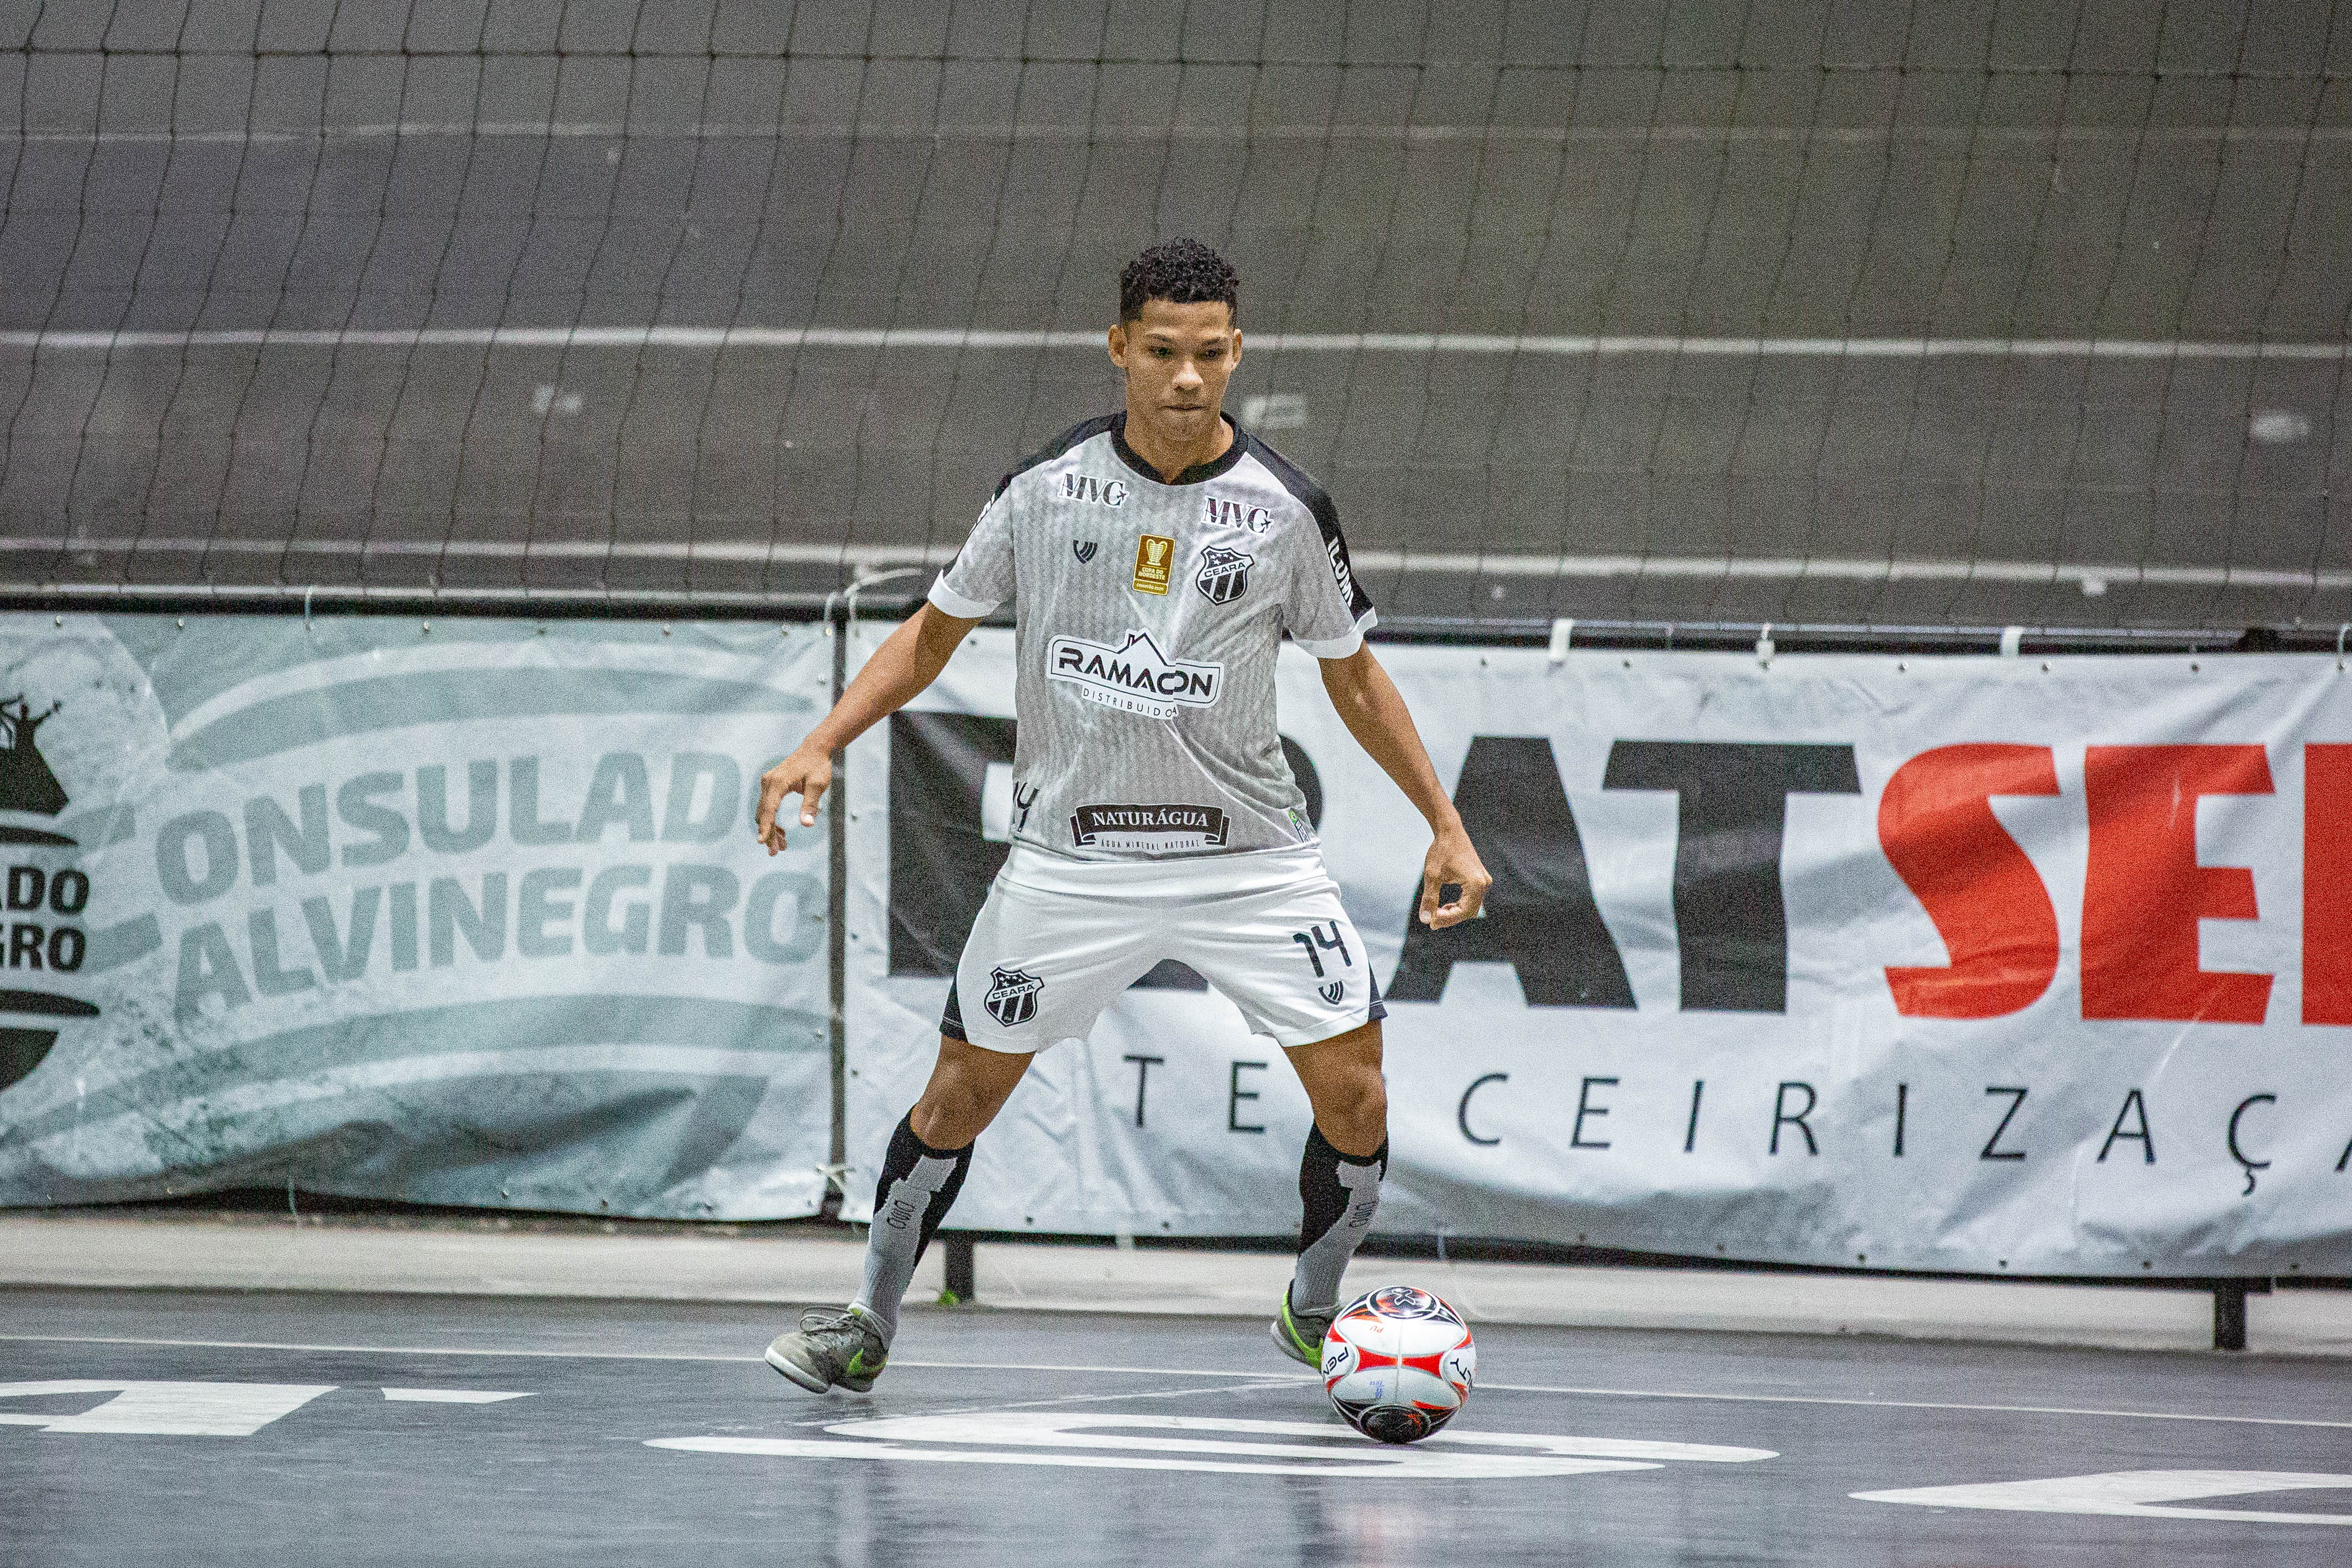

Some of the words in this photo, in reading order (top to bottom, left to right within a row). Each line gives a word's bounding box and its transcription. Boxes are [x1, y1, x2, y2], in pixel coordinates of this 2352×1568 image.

[1059, 473, 1125, 506] MVC
[1202, 497, 1269, 534] MVC
[1138, 571, 1165, 580] NORDESTE
[1091, 808, 1208, 827] NATURÁGUA
[1165, 839, 1200, 849] NATURAL
[173, 862, 827, 1025] ALVINEGRO
[1292, 919, 1353, 978] 14
